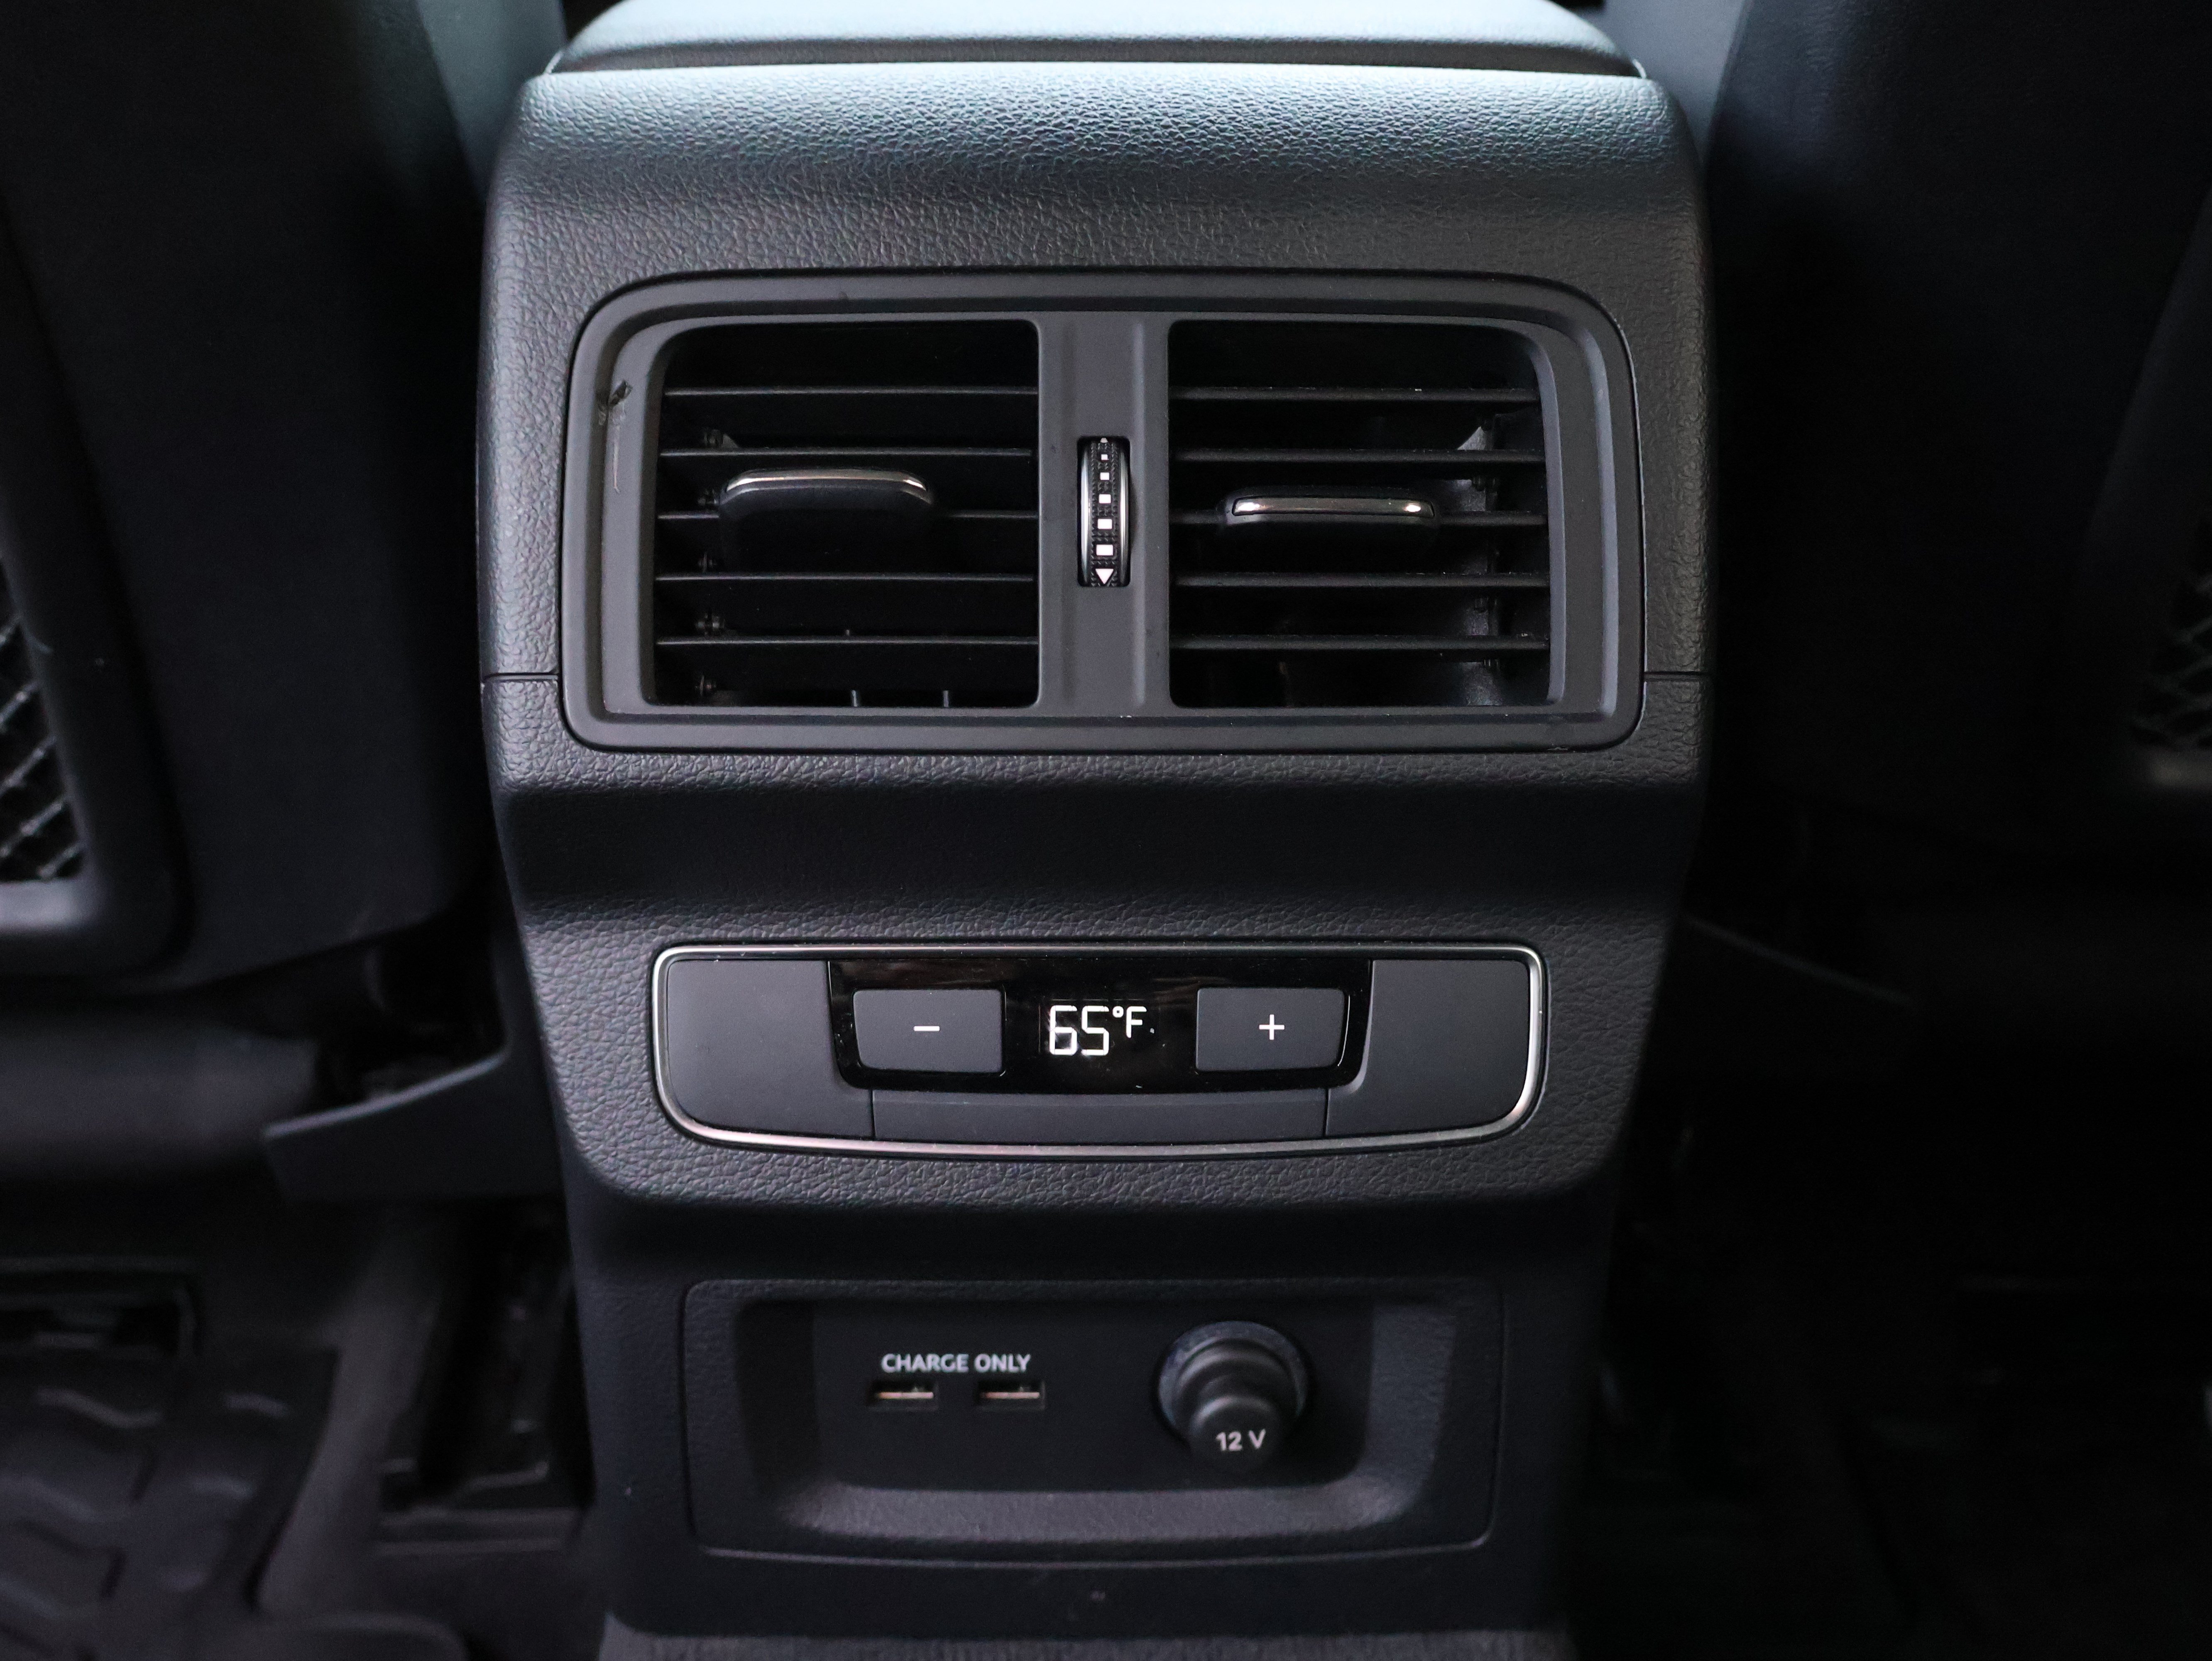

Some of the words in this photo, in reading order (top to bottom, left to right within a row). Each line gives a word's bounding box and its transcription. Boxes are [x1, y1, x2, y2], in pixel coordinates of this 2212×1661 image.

[1049, 1005, 1147, 1056] 65°F
[881, 1353, 969, 1373] CHARGE
[974, 1353, 1031, 1373] ONLY
[1216, 1431, 1243, 1451] 12
[1248, 1428, 1266, 1449] V
